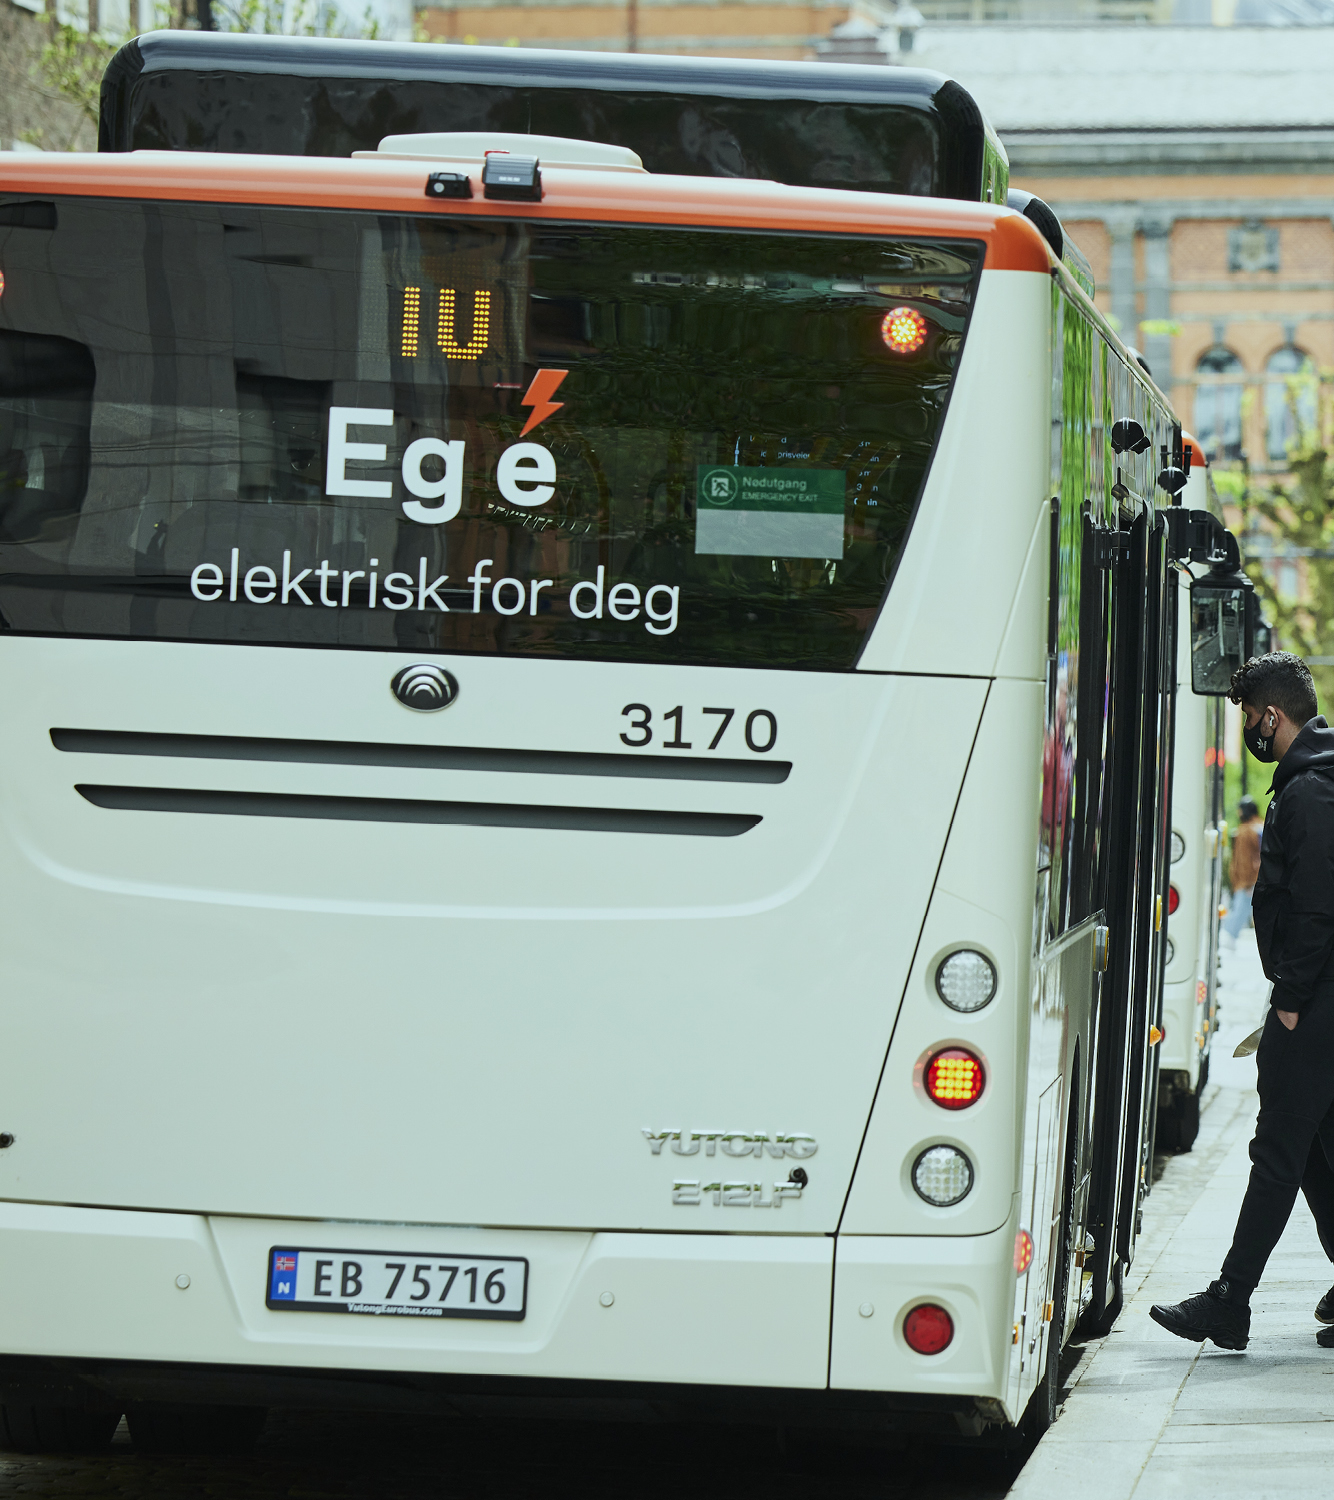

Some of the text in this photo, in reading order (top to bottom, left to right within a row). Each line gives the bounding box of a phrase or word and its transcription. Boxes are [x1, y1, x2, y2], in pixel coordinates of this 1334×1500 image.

[326, 407, 465, 524] Eg
[741, 491, 819, 503] EMERGENCY EXIT
[742, 476, 808, 492] Nødutgang
[191, 548, 679, 635] elektrisk for deg
[619, 703, 777, 753] 3170
[641, 1128, 818, 1159] YUTONG
[672, 1179, 802, 1208] E12LF
[278, 1282, 290, 1294] N
[314, 1260, 506, 1304] EB 75716
